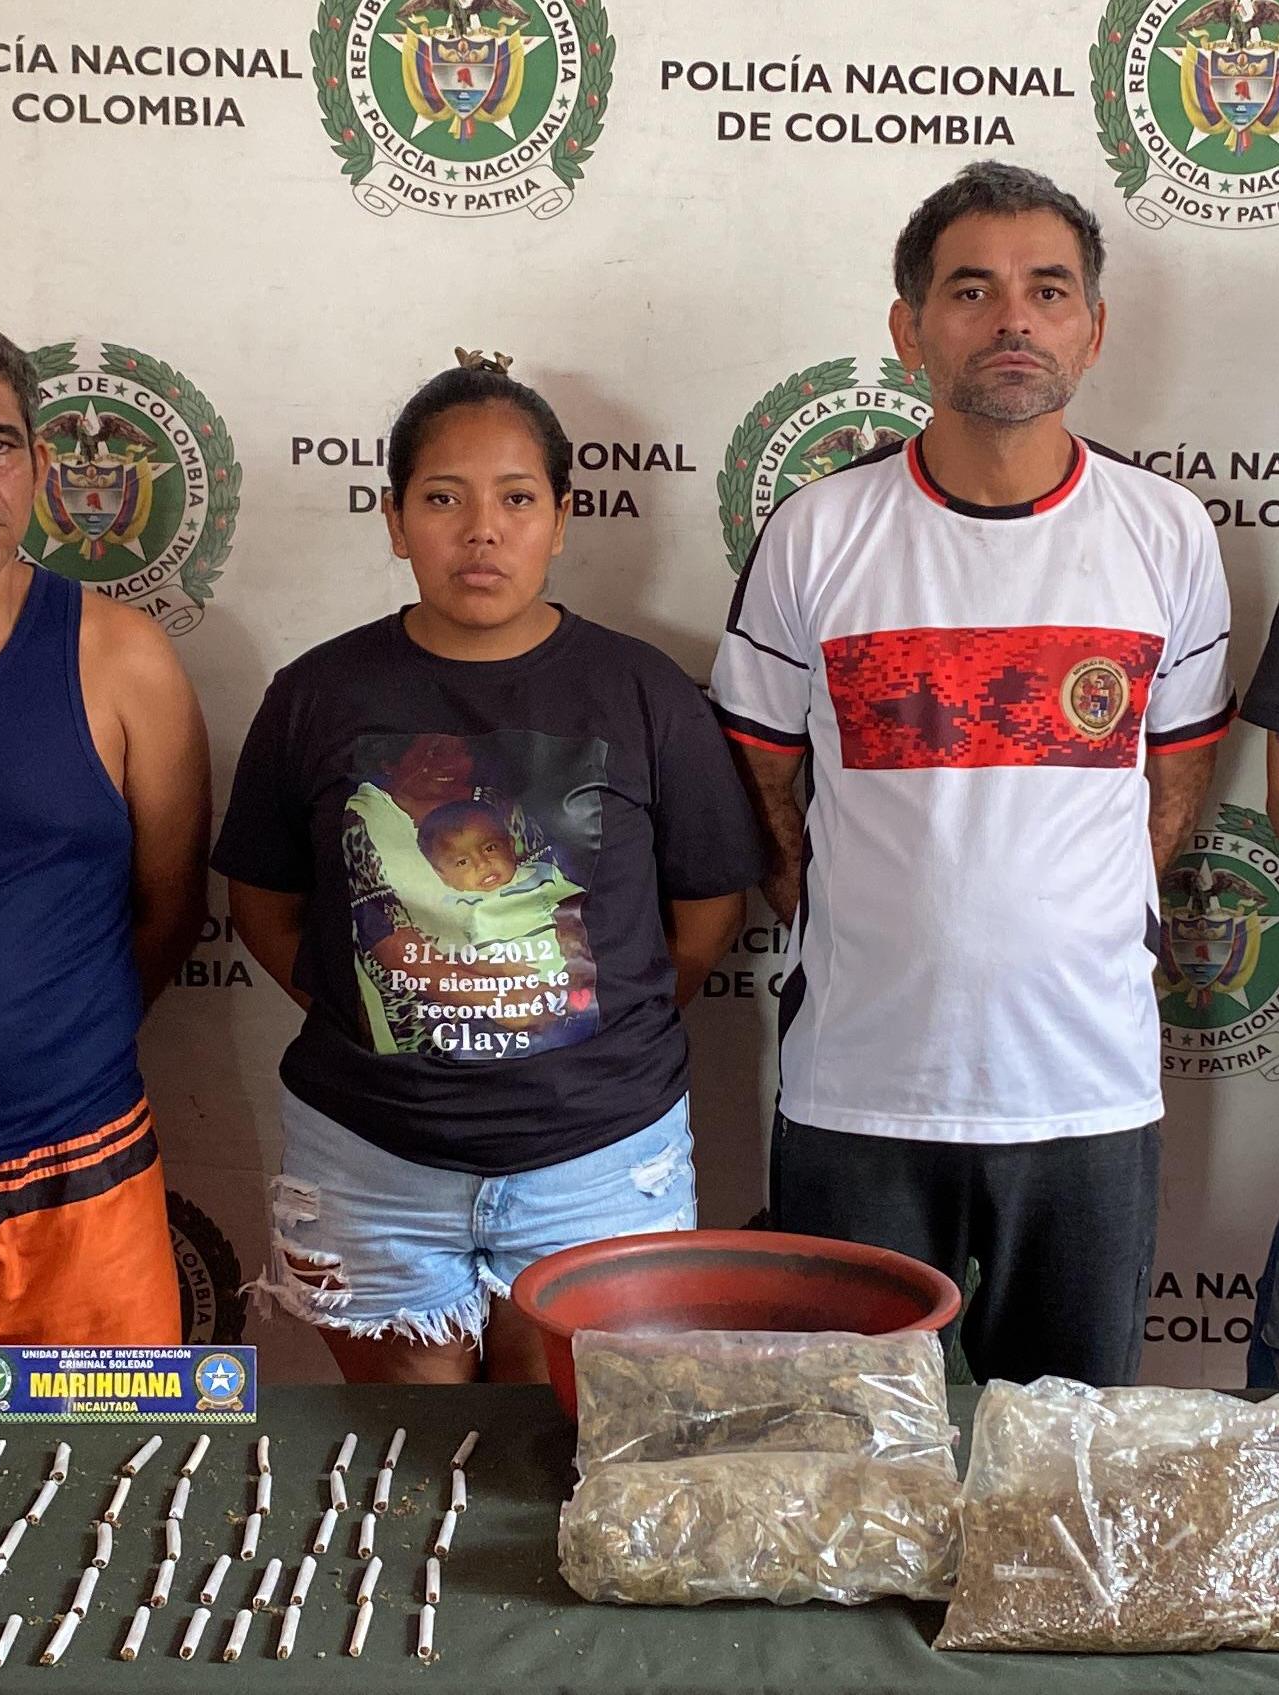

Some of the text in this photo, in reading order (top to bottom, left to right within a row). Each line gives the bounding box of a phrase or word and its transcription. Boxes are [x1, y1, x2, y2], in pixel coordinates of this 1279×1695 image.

[351, 0, 385, 79] REPÚB
[541, 0, 577, 83] OMBIA
[1129, 0, 1177, 92] REPÚBL
[71, 44, 303, 79] NACIONAL
[661, 54, 1075, 97] POLICÍA NACIONAL
[12, 93, 245, 127] COLOMBIA
[363, 109, 566, 181] POLICÍA NACIONAL
[718, 111, 1015, 146] DE COLOMBIA
[1139, 122, 1210, 190] POLICÍA
[466, 178, 541, 210] PATRIA
[78, 377, 109, 393] DE
[856, 391, 887, 407] DE
[134, 391, 204, 508] COLOMBIA
[292, 436, 697, 472] POLI IONAL
[756, 401, 832, 518] REPÚBLICA
[96, 534, 195, 600] NACIONAL
[1194, 835, 1225, 850] DE
[403, 940, 554, 965] 31-10-2012
[390, 970, 569, 997] Por siempre te
[417, 994, 543, 1019] recordaré
[432, 1022, 530, 1058] Glays
[1198, 1044, 1272, 1073] PATRIA
[22, 1349, 191, 1359] UNIDAD BÁSICA DE INVESTIGACIÓN
[59, 1360, 154, 1369] CRIMINAL SOLEDAD
[30, 1372, 182, 1398] MARIHUANA
[72, 1401, 138, 1412] INCAUTADA
